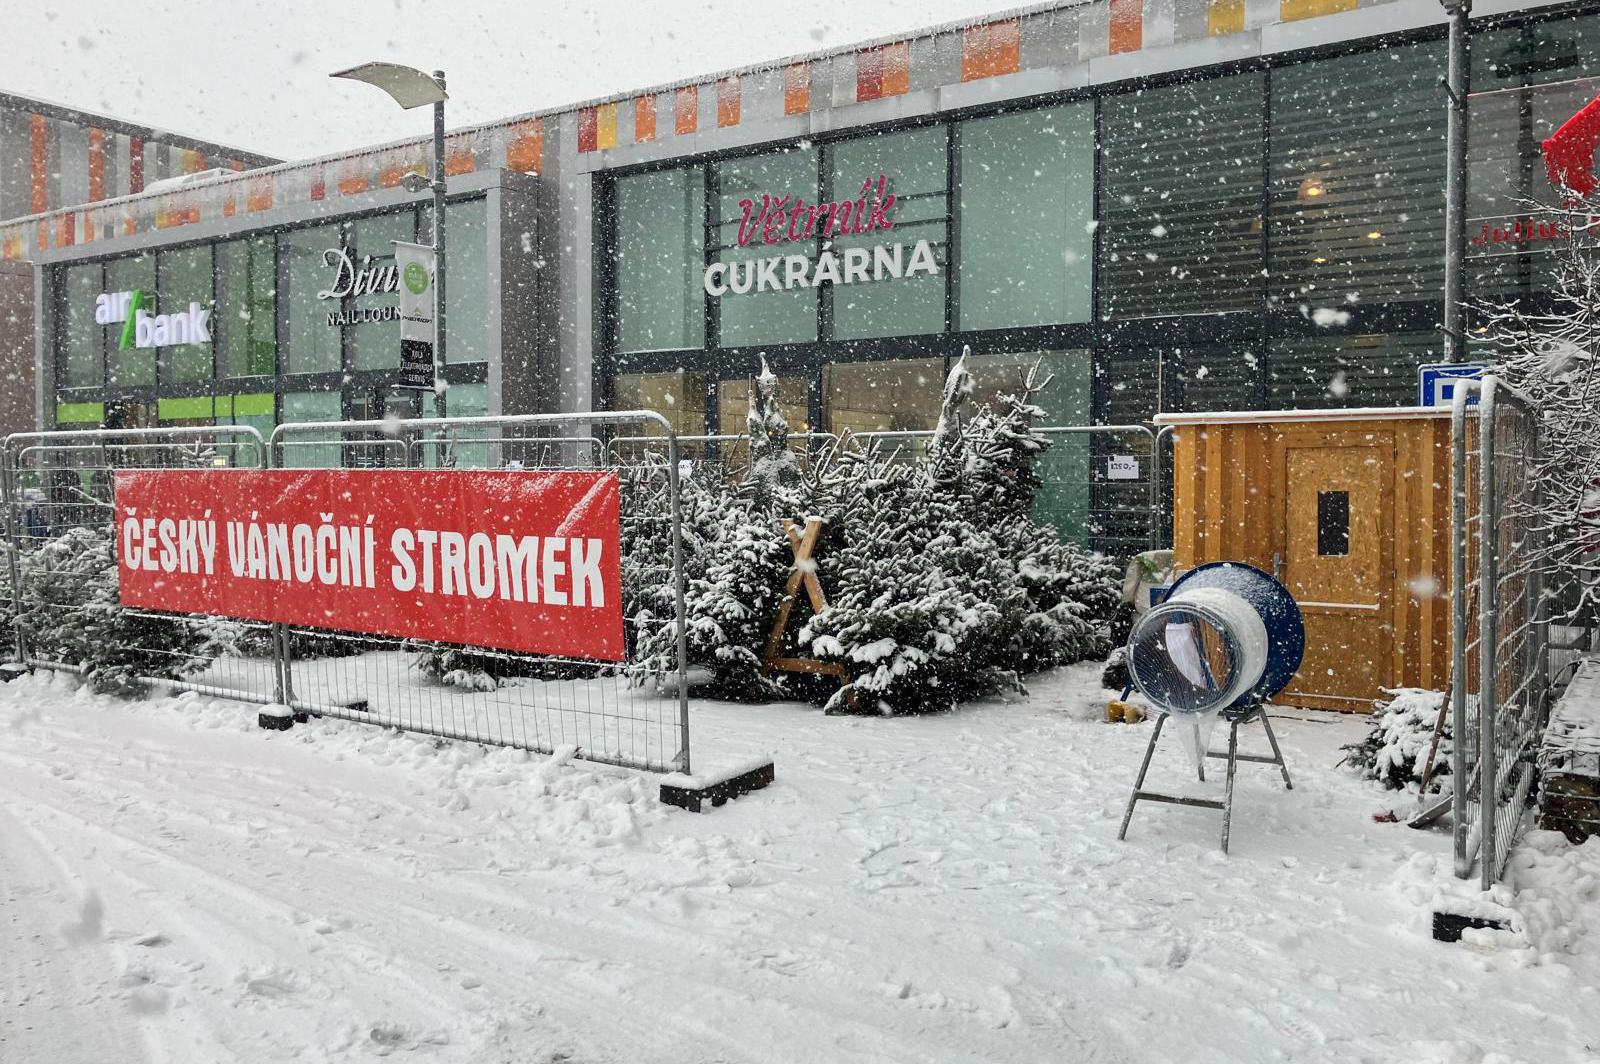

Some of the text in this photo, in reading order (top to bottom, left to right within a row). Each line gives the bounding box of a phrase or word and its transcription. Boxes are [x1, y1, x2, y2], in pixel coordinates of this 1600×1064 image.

[738, 174, 897, 247] Větrník
[704, 239, 940, 296] CUKRÁRNA
[136, 301, 212, 348] bank
[326, 306, 401, 327] NAIL LOUN
[123, 508, 605, 608] ČESKÝ VÁNOČNÍ STROMEK
